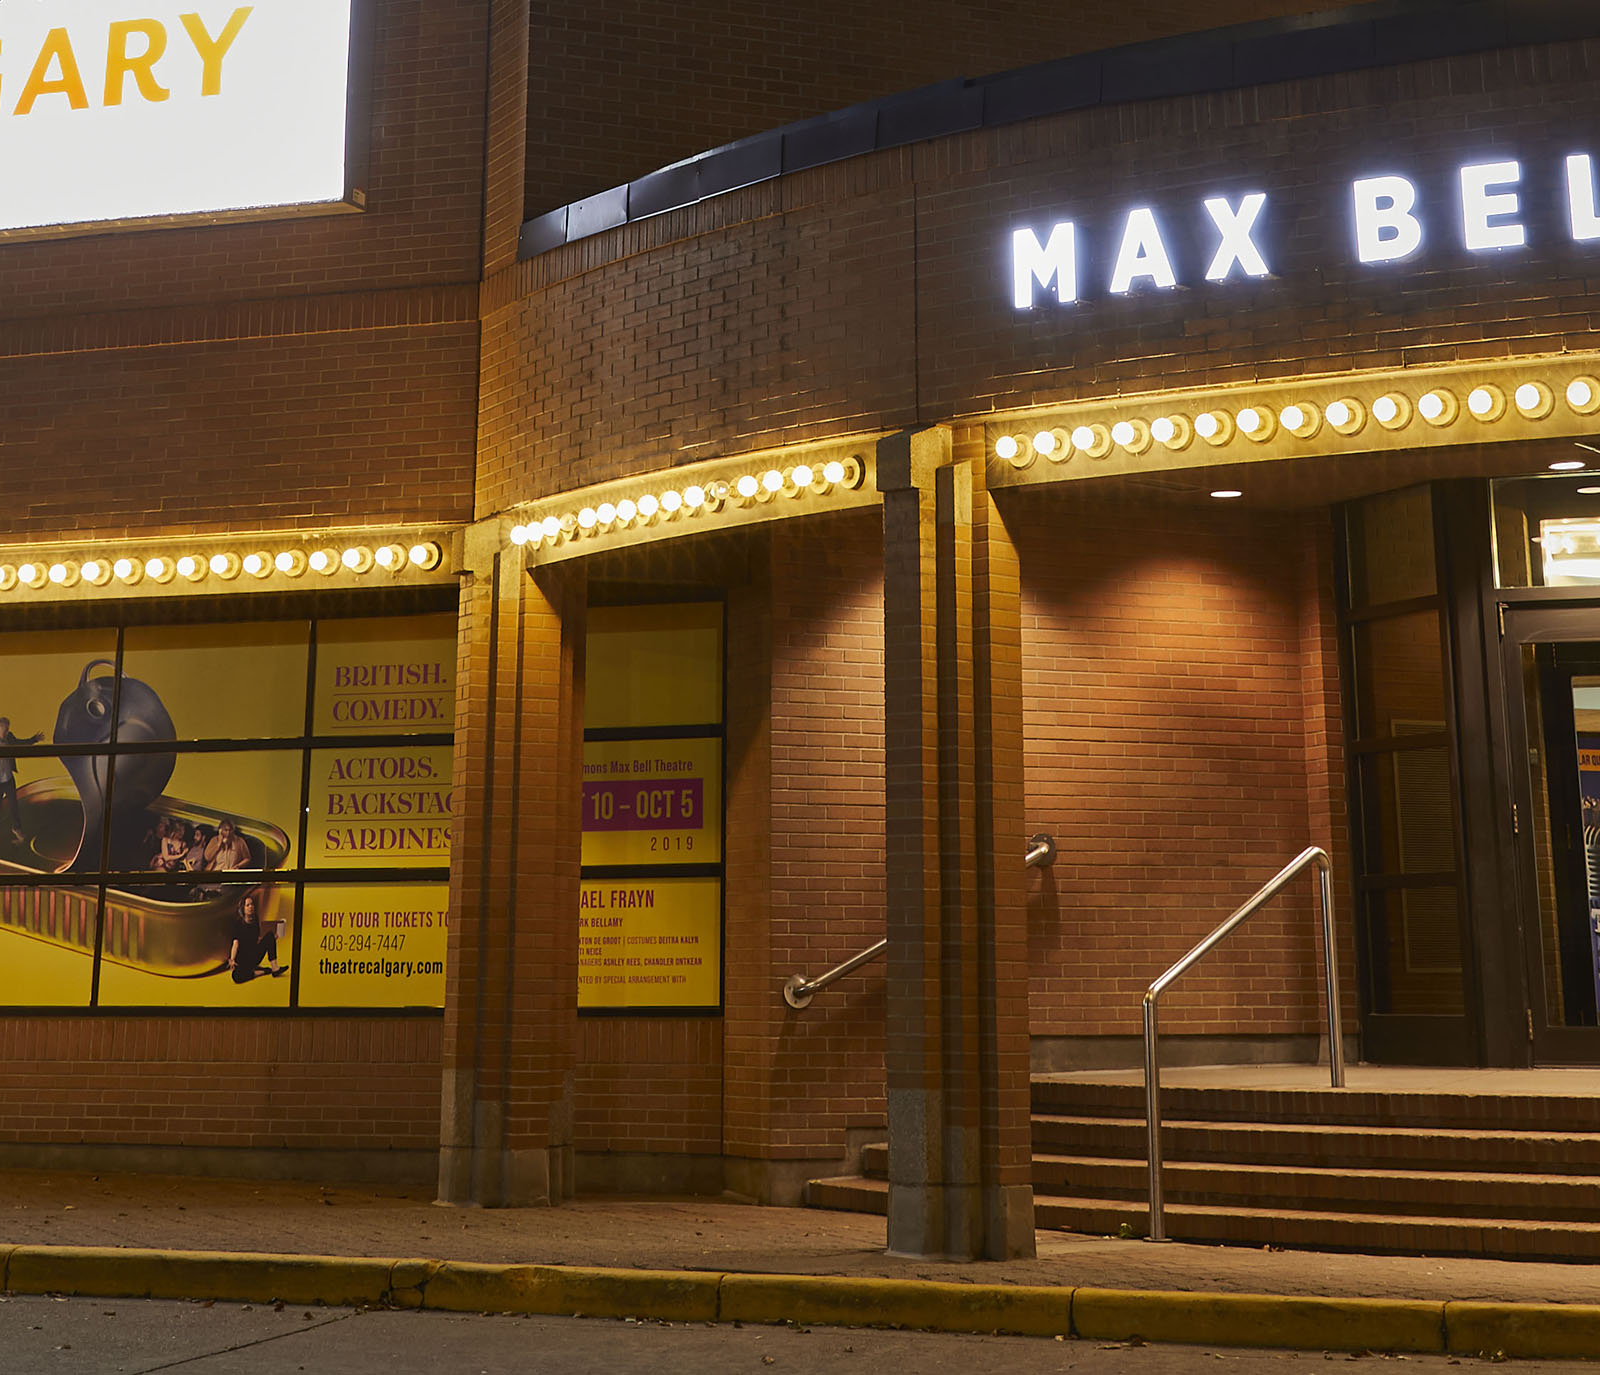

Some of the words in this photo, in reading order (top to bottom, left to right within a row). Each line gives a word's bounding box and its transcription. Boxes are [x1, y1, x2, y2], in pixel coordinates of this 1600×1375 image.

[1012, 191, 1271, 310] MAX
[335, 663, 448, 688] BRITISH.
[332, 698, 445, 722] COMEDY.
[328, 756, 439, 780] ACTORS.
[610, 761, 630, 773] Max
[633, 759, 652, 773] Bell
[654, 759, 693, 772] Theatre
[591, 792, 613, 820] 10
[636, 790, 675, 819] OCT
[681, 789, 693, 818] 5
[650, 836, 693, 851] 2019
[610, 890, 654, 908] FRAYN
[321, 912, 345, 928] BUY
[349, 912, 380, 928] YOUR
[383, 911, 433, 928] TICKETS
[591, 917, 624, 928] BELLAMY
[320, 934, 406, 951] 403-294-7447
[319, 957, 443, 978] theatrecalgary.com
